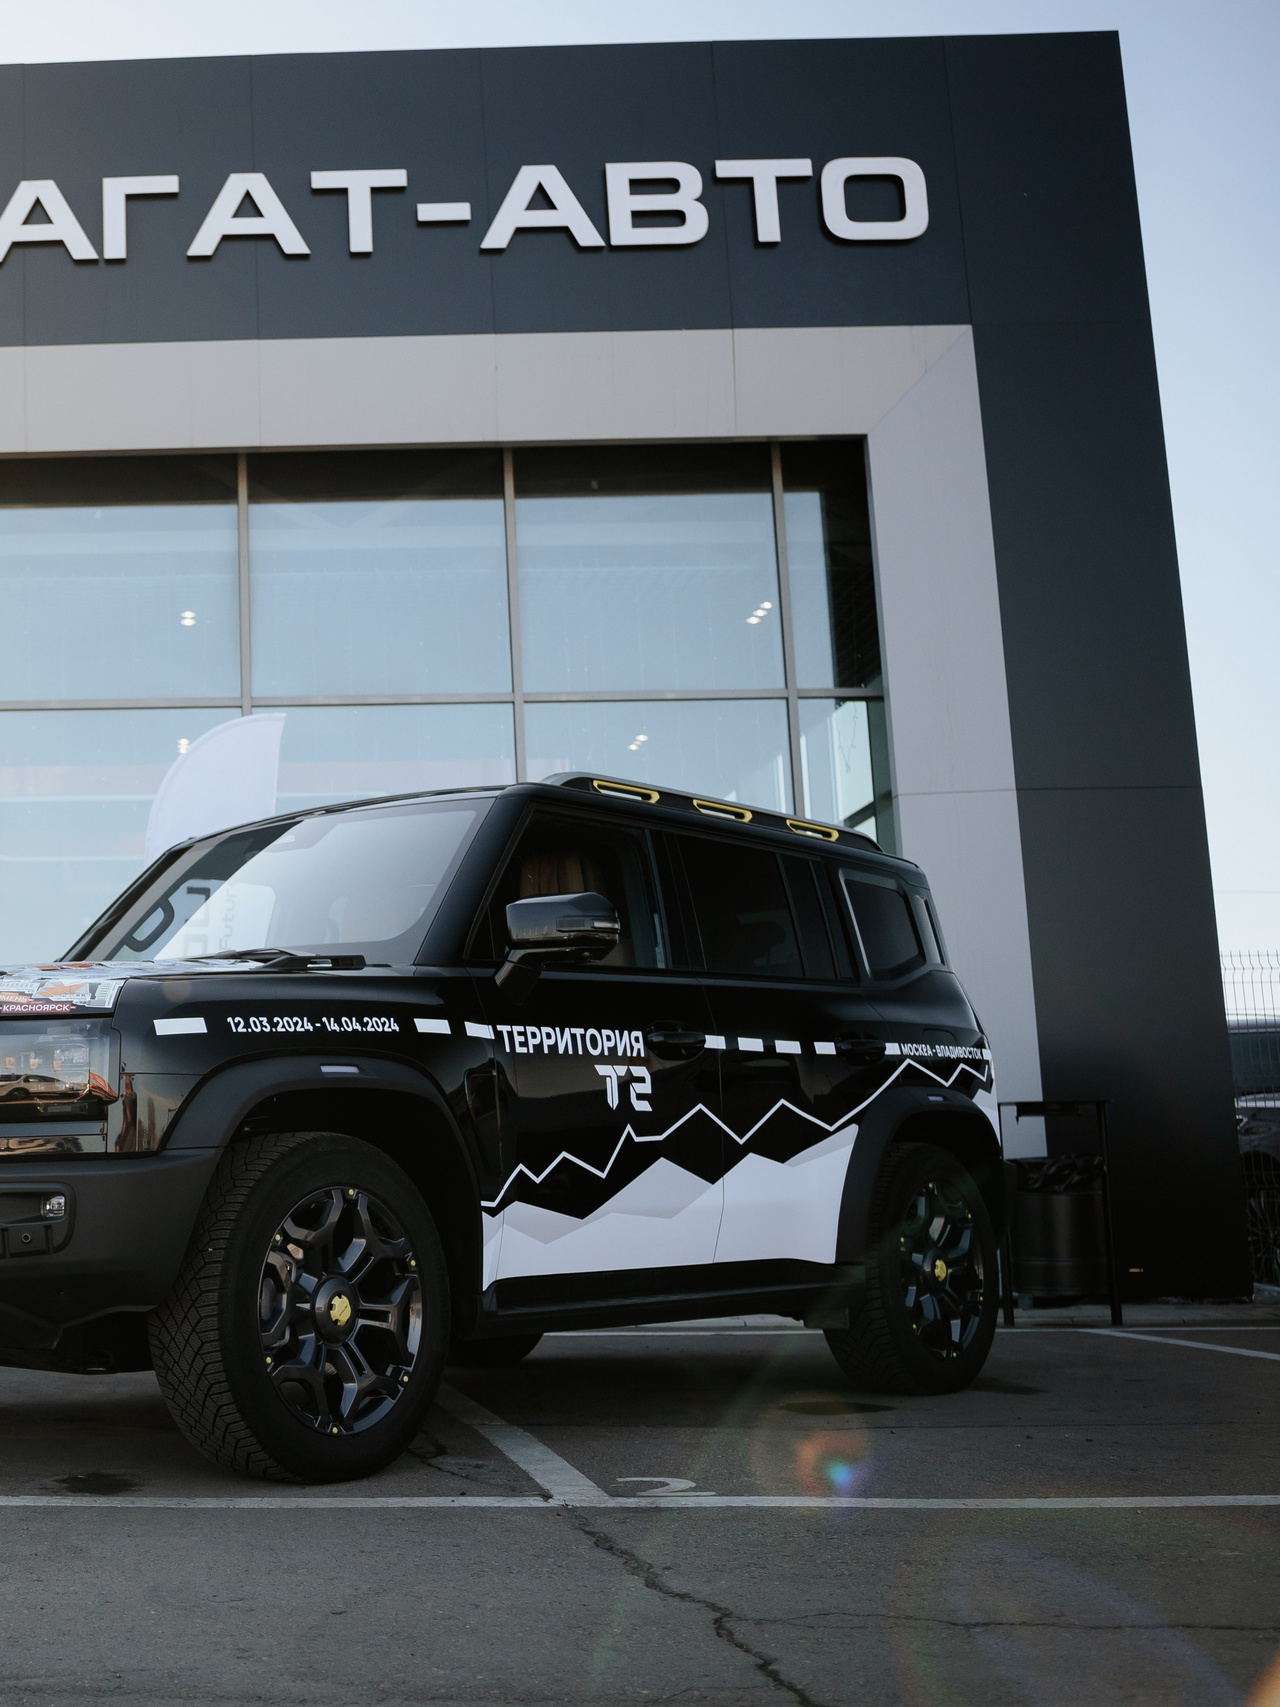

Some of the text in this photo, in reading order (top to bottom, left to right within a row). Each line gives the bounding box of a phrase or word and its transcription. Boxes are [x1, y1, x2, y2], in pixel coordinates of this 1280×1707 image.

[3, 1003, 70, 1012] КРАСНОЯРСК
[496, 1024, 645, 1057] ТЕРРИТОРИЯ
[593, 1064, 653, 1112] T2
